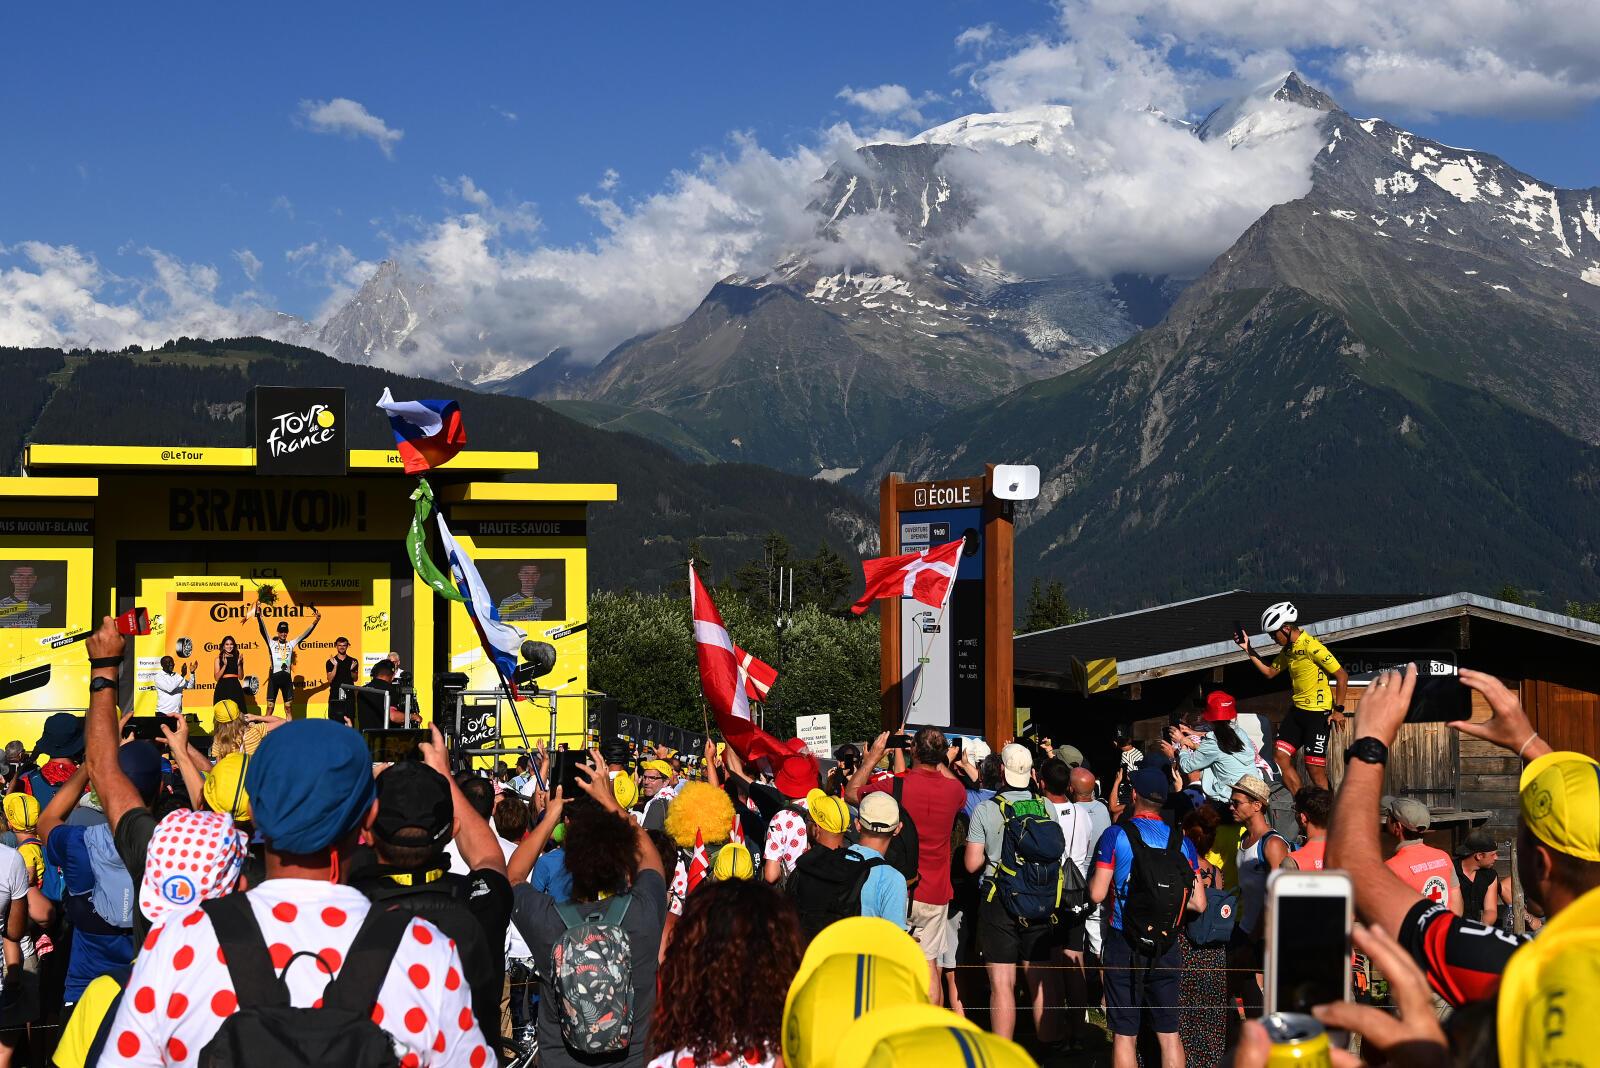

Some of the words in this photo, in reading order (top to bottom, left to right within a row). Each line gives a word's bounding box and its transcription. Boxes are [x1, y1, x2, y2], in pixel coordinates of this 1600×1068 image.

[309, 423, 320, 432] de
[161, 450, 204, 461] @LeTour
[929, 484, 971, 505] ÉCOLE
[17, 521, 89, 532] MONT-BLANC
[479, 522, 561, 535] HAUTE-SAVOIE
[905, 526, 928, 534] OUVERTURE
[933, 528, 946, 536] 9h00
[252, 568, 282, 578] LCL
[300, 579, 360, 588] HAUTE-SAVOIE
[209, 603, 304, 622] Contiental
[1321, 654, 1333, 664] LCL
[1344, 658, 1373, 673] cole
[1316, 689, 1324, 706] LCL
[461, 727, 496, 745] rance
[1313, 733, 1326, 755] UAE
[1060, 808, 1071, 817] NIKE
[122, 888, 130, 922] SALOMON
